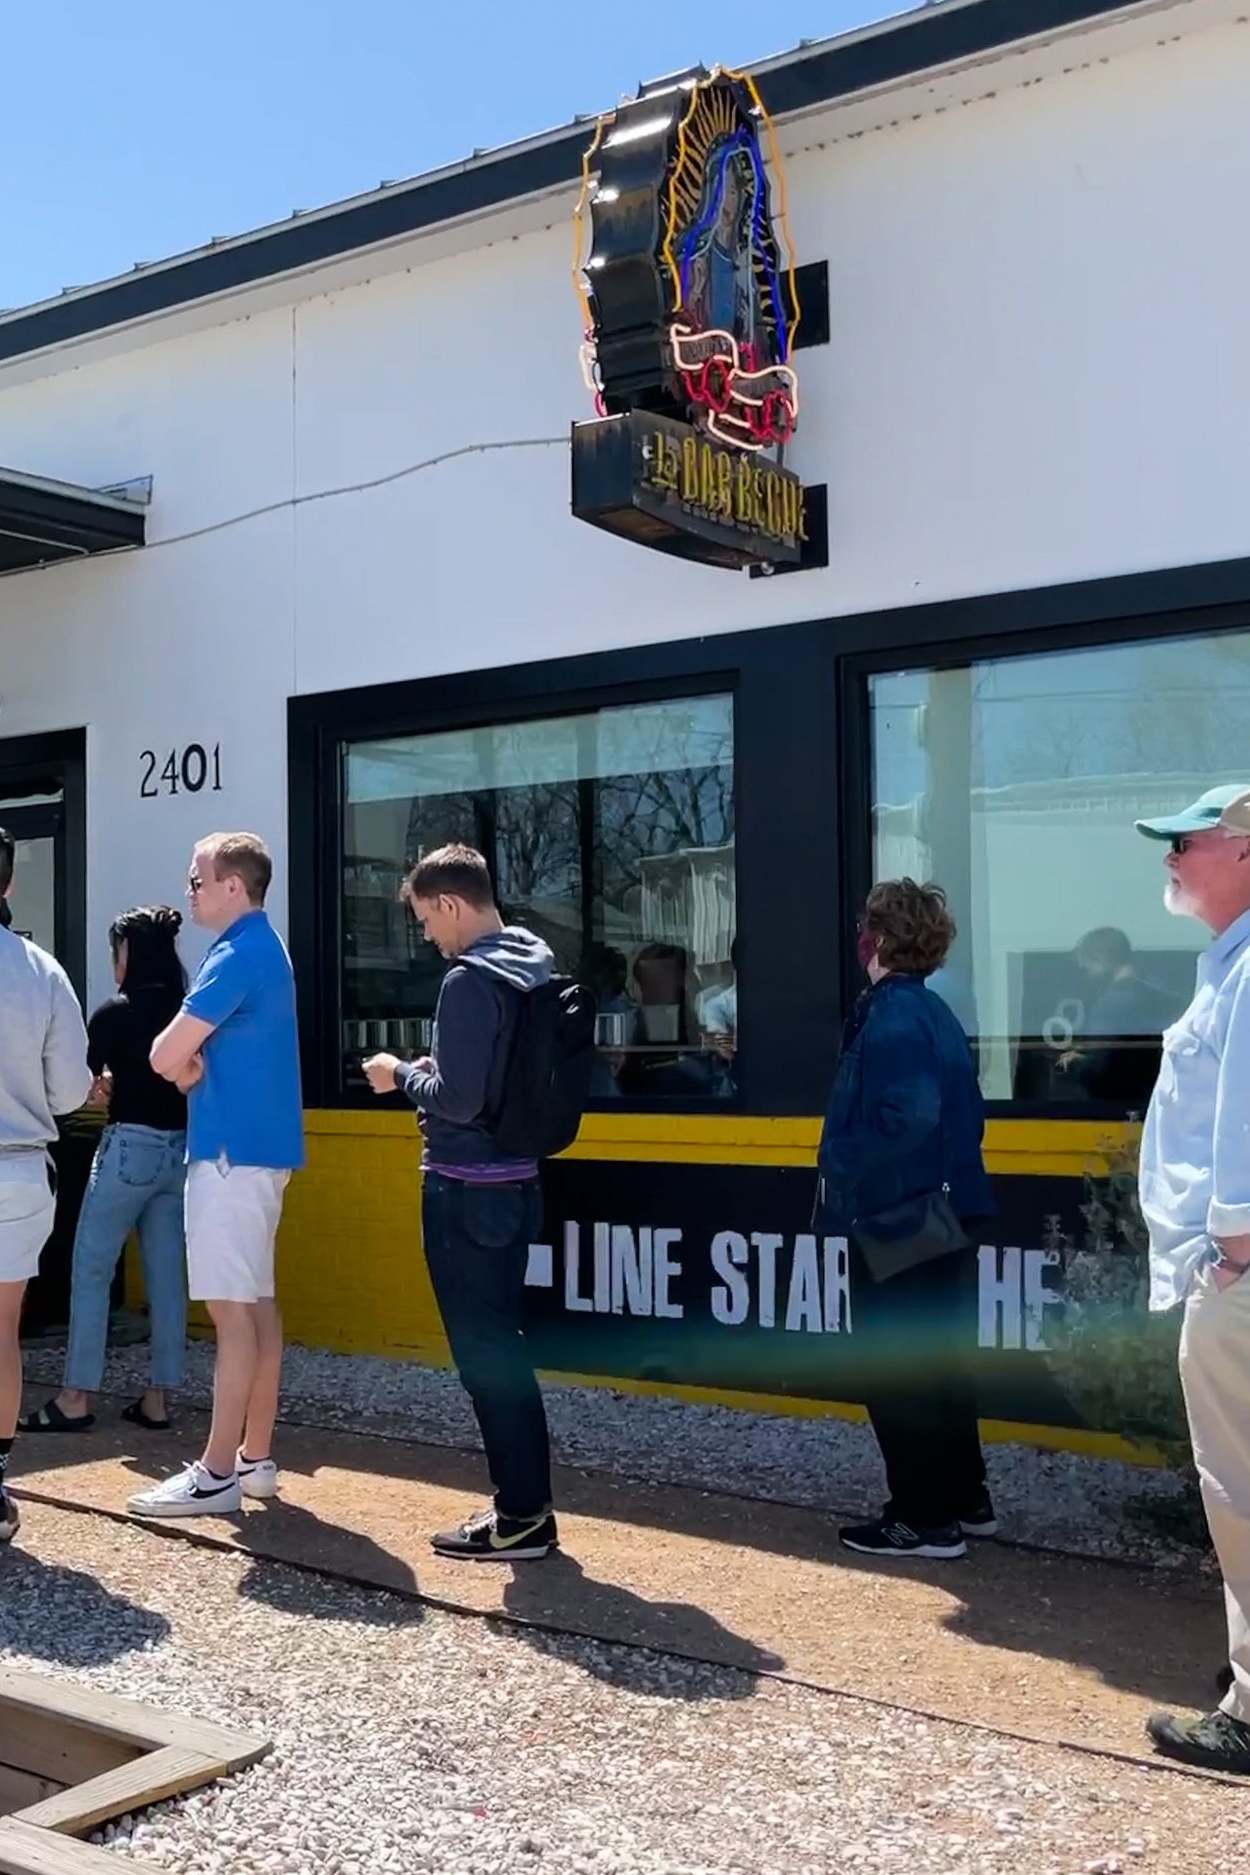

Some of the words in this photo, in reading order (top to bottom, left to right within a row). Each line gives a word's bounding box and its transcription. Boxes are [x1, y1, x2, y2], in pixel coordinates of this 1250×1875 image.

[683, 436, 808, 541] BARBECUE
[138, 742, 223, 799] 2401
[563, 1219, 684, 1319] LINE
[709, 1229, 853, 1334] STAR
[976, 1245, 1061, 1352] HE
